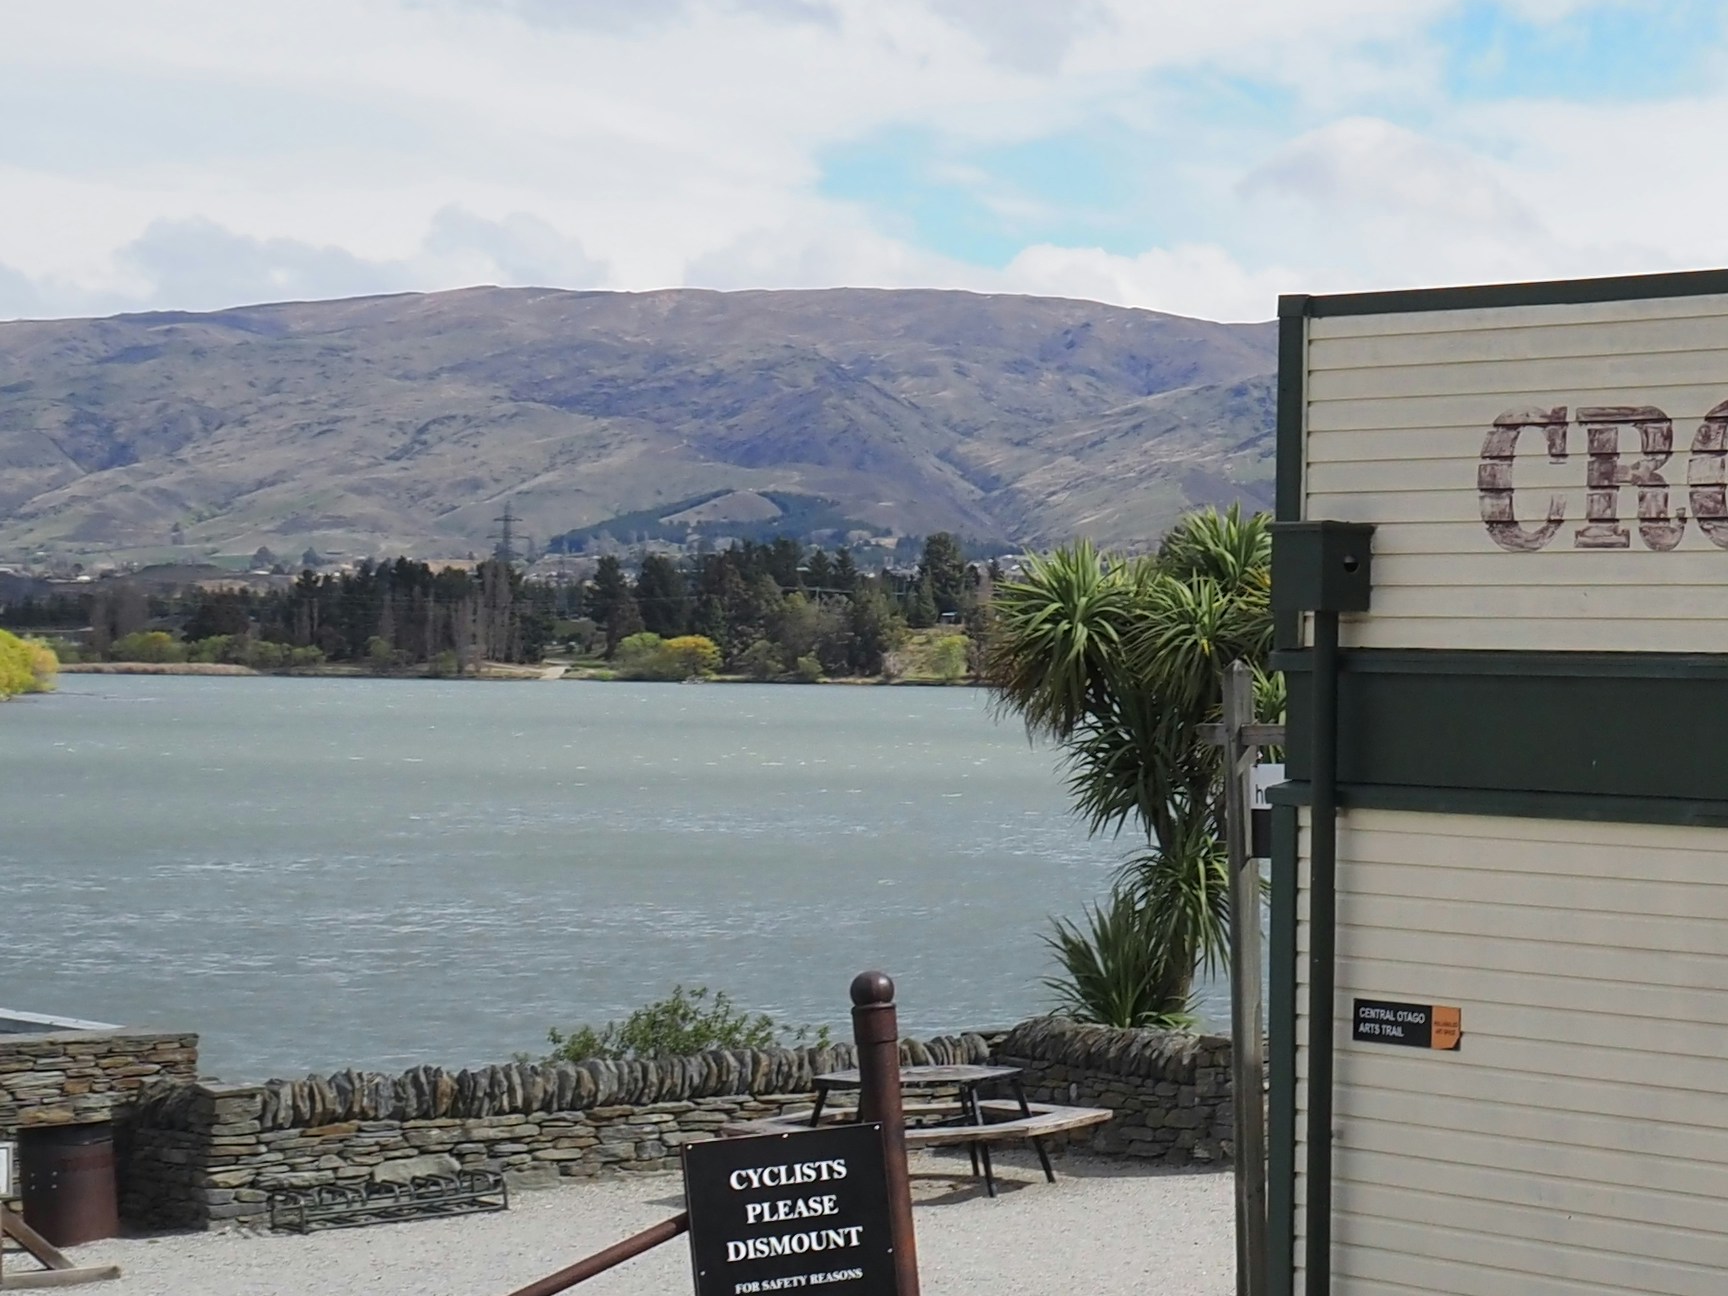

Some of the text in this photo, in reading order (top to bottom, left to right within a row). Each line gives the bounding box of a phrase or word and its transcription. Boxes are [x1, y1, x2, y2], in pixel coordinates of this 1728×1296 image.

[1359, 1007, 1426, 1024] CENTRAL OTAGO
[1359, 1022, 1404, 1037] ARTS TRAIL
[729, 1159, 847, 1190] CYCLISTS
[746, 1195, 839, 1224] PLEASE
[726, 1226, 863, 1262] DISMOUNT
[735, 1268, 863, 1295] FOR SAFETY REASONS
